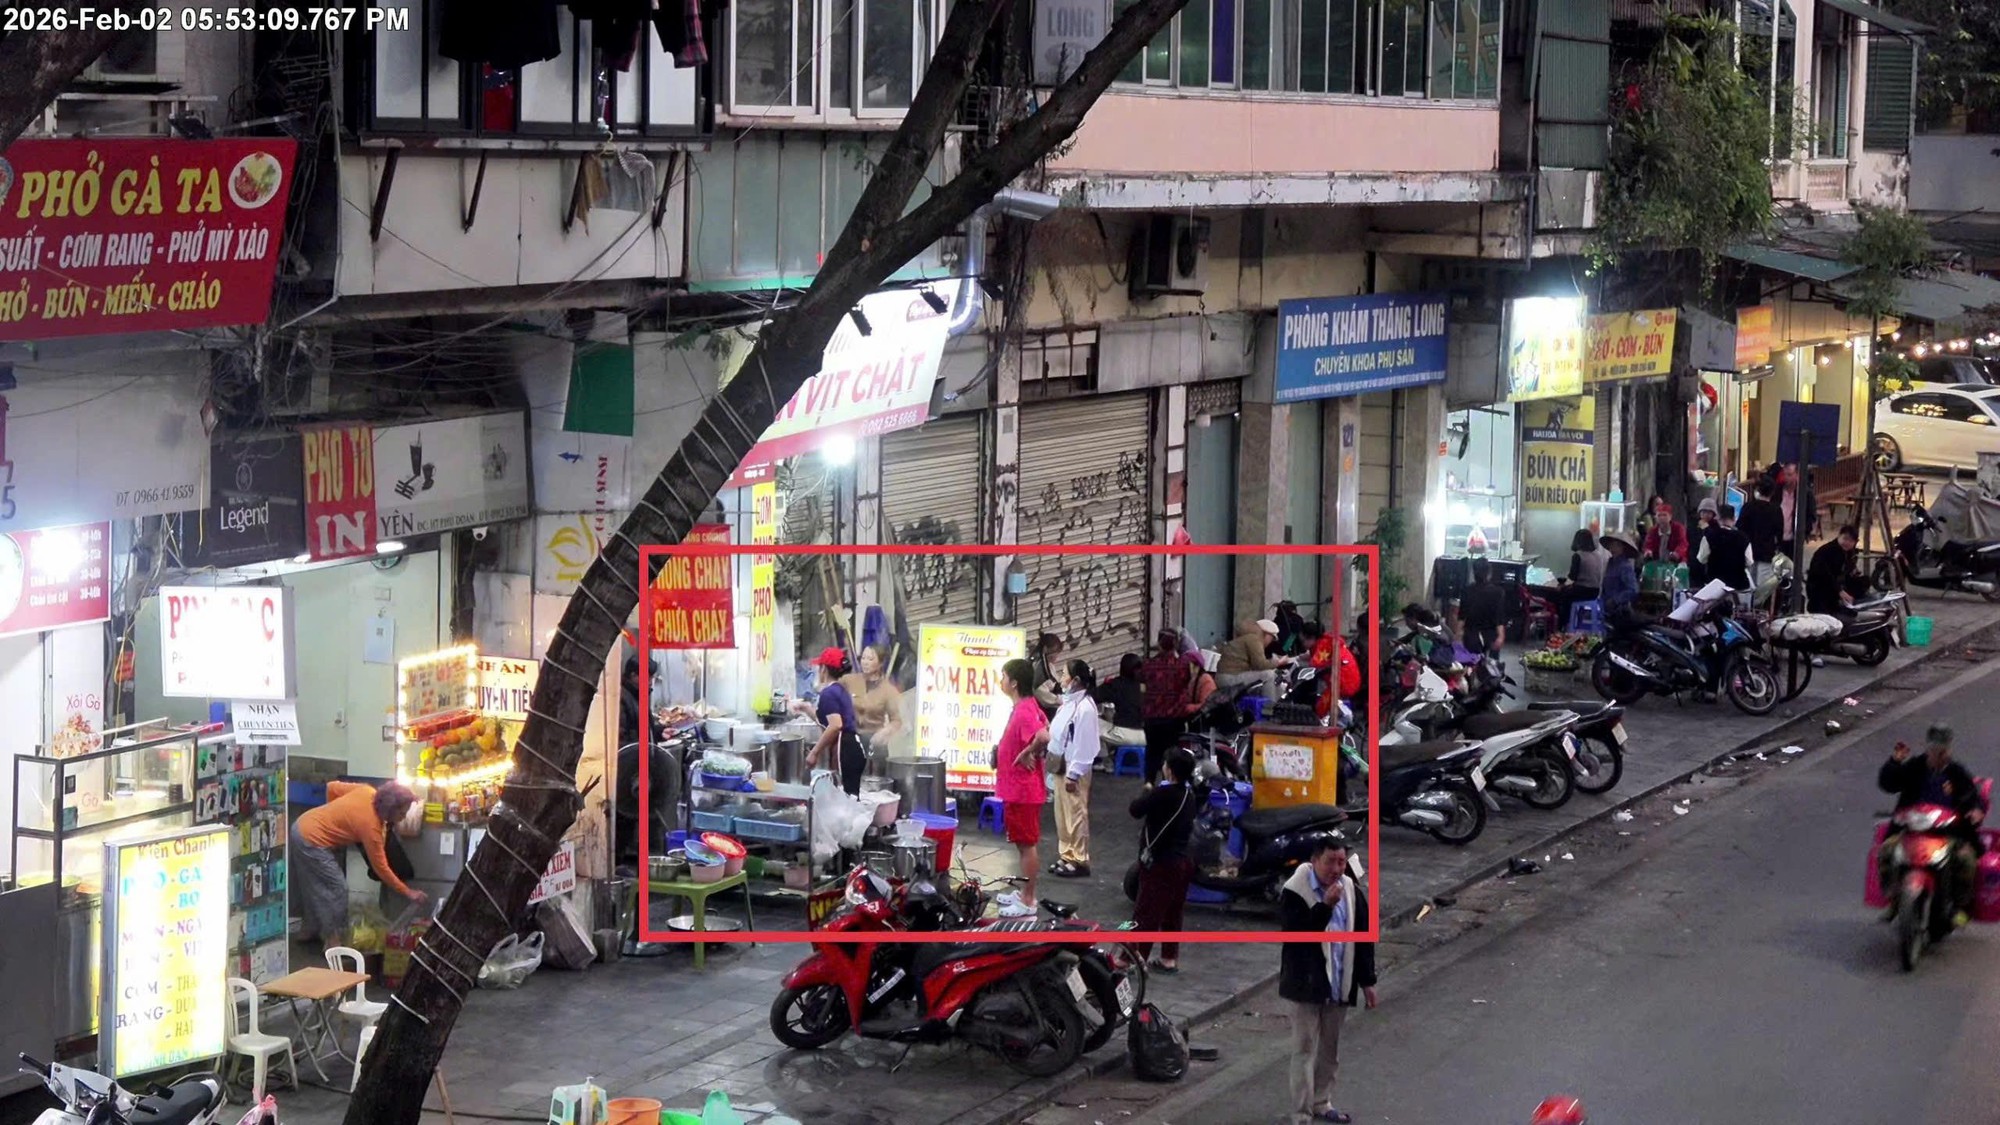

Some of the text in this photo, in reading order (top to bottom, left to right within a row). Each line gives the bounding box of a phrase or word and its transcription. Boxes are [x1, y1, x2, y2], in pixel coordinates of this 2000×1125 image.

[1047, 7, 1095, 37] LONG
[17, 150, 222, 218] PHỞ GÀ TA
[59, 231, 102, 268] CƠM
[104, 232, 154, 266] RANG
[167, 219, 205, 264] PHỞ
[42, 280, 90, 319] BÚN
[168, 271, 221, 311] CHÁO
[1284, 300, 1445, 350] PHÒNG KHÁM THĂNG LONG
[1315, 351, 1351, 376] CHUYÊN
[1352, 352, 1376, 373] KHOA
[1377, 350, 1395, 373] PHỤ
[804, 370, 851, 425] VỊT
[353, 426, 374, 498] TO
[1528, 449, 1587, 482] BÚN CHẢ
[1525, 484, 1544, 503] BÚN
[220, 501, 269, 533] Legend
[316, 511, 367, 556] IN
[654, 602, 728, 643] CHỮA CHÁY
[248, 704, 280, 717] NHẬN
